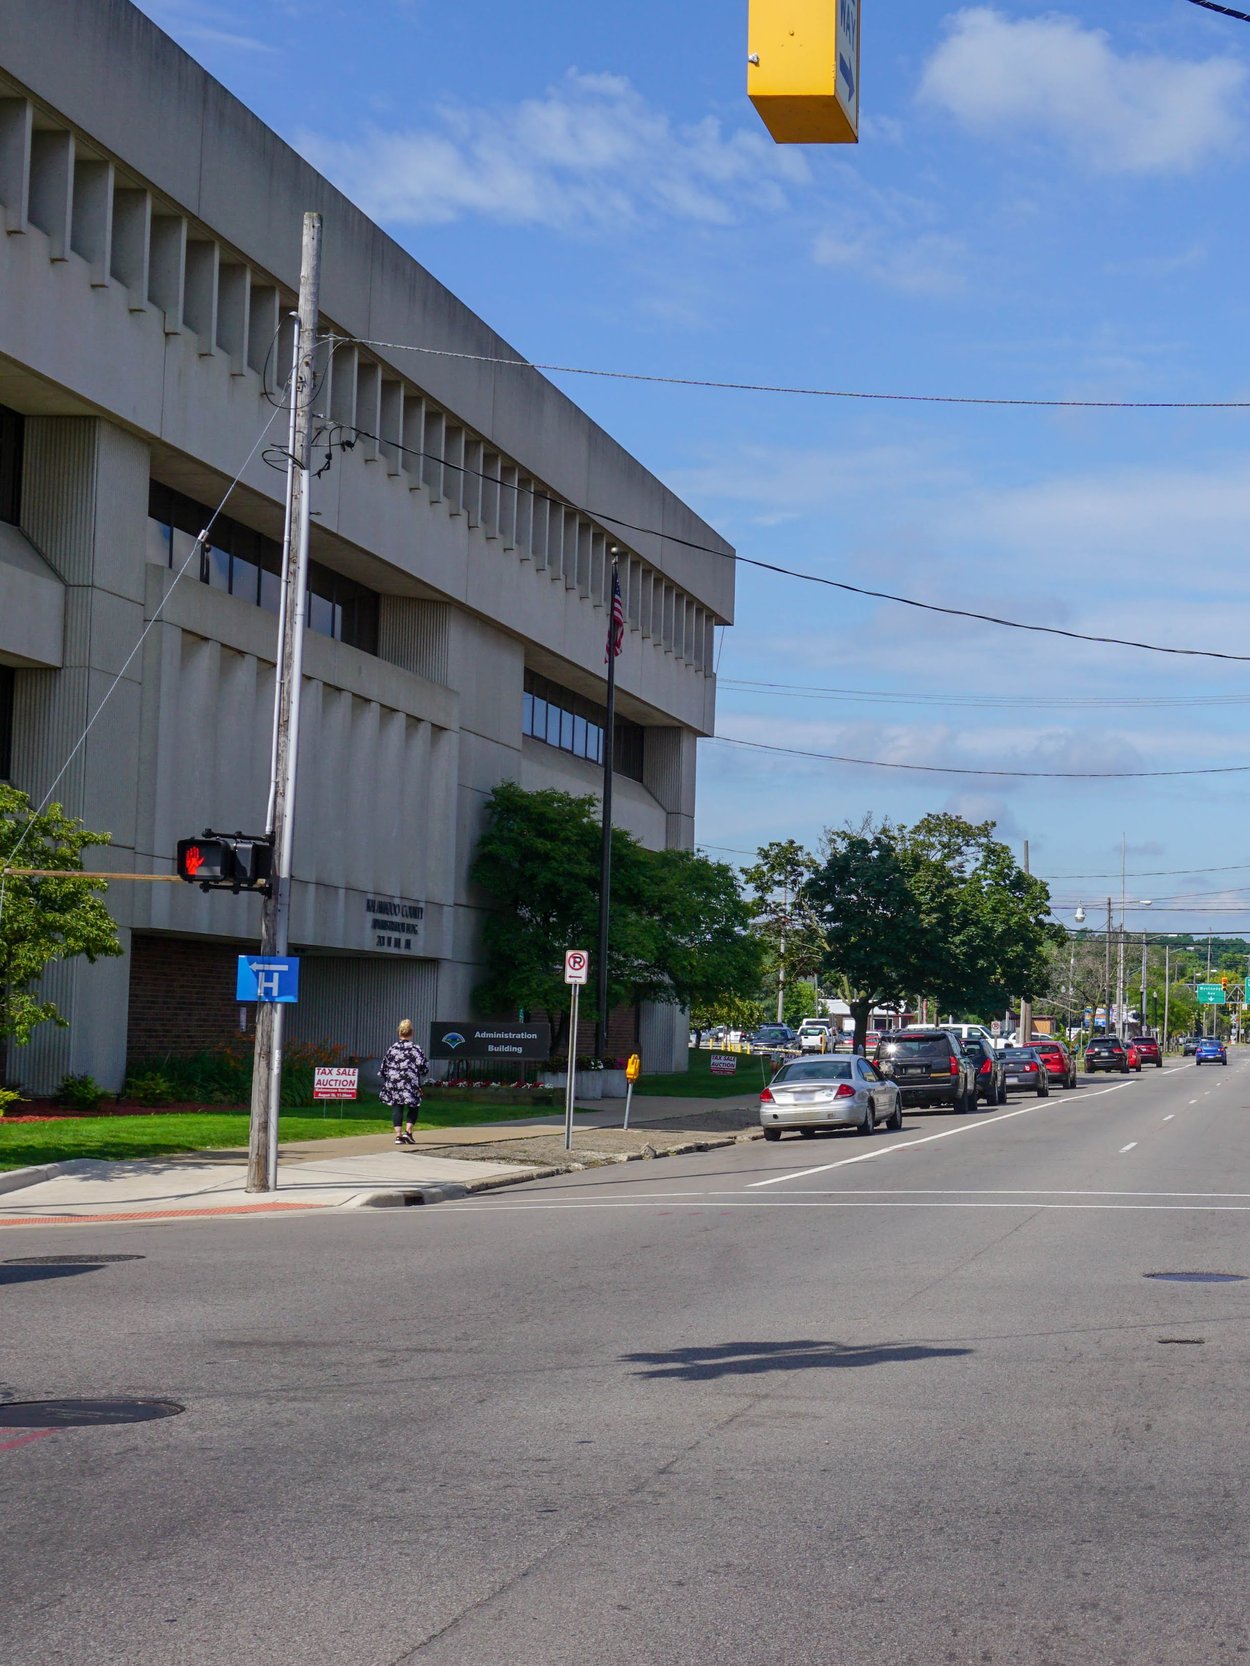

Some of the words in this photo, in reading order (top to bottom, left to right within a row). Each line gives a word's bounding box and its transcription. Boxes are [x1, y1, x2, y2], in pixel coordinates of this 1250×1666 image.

[258, 972, 279, 996] H
[474, 1031, 537, 1039] Administration
[488, 1045, 523, 1053] Building
[316, 1068, 333, 1076] TAX
[336, 1068, 356, 1076] SALE
[315, 1079, 356, 1087] AUCTION
